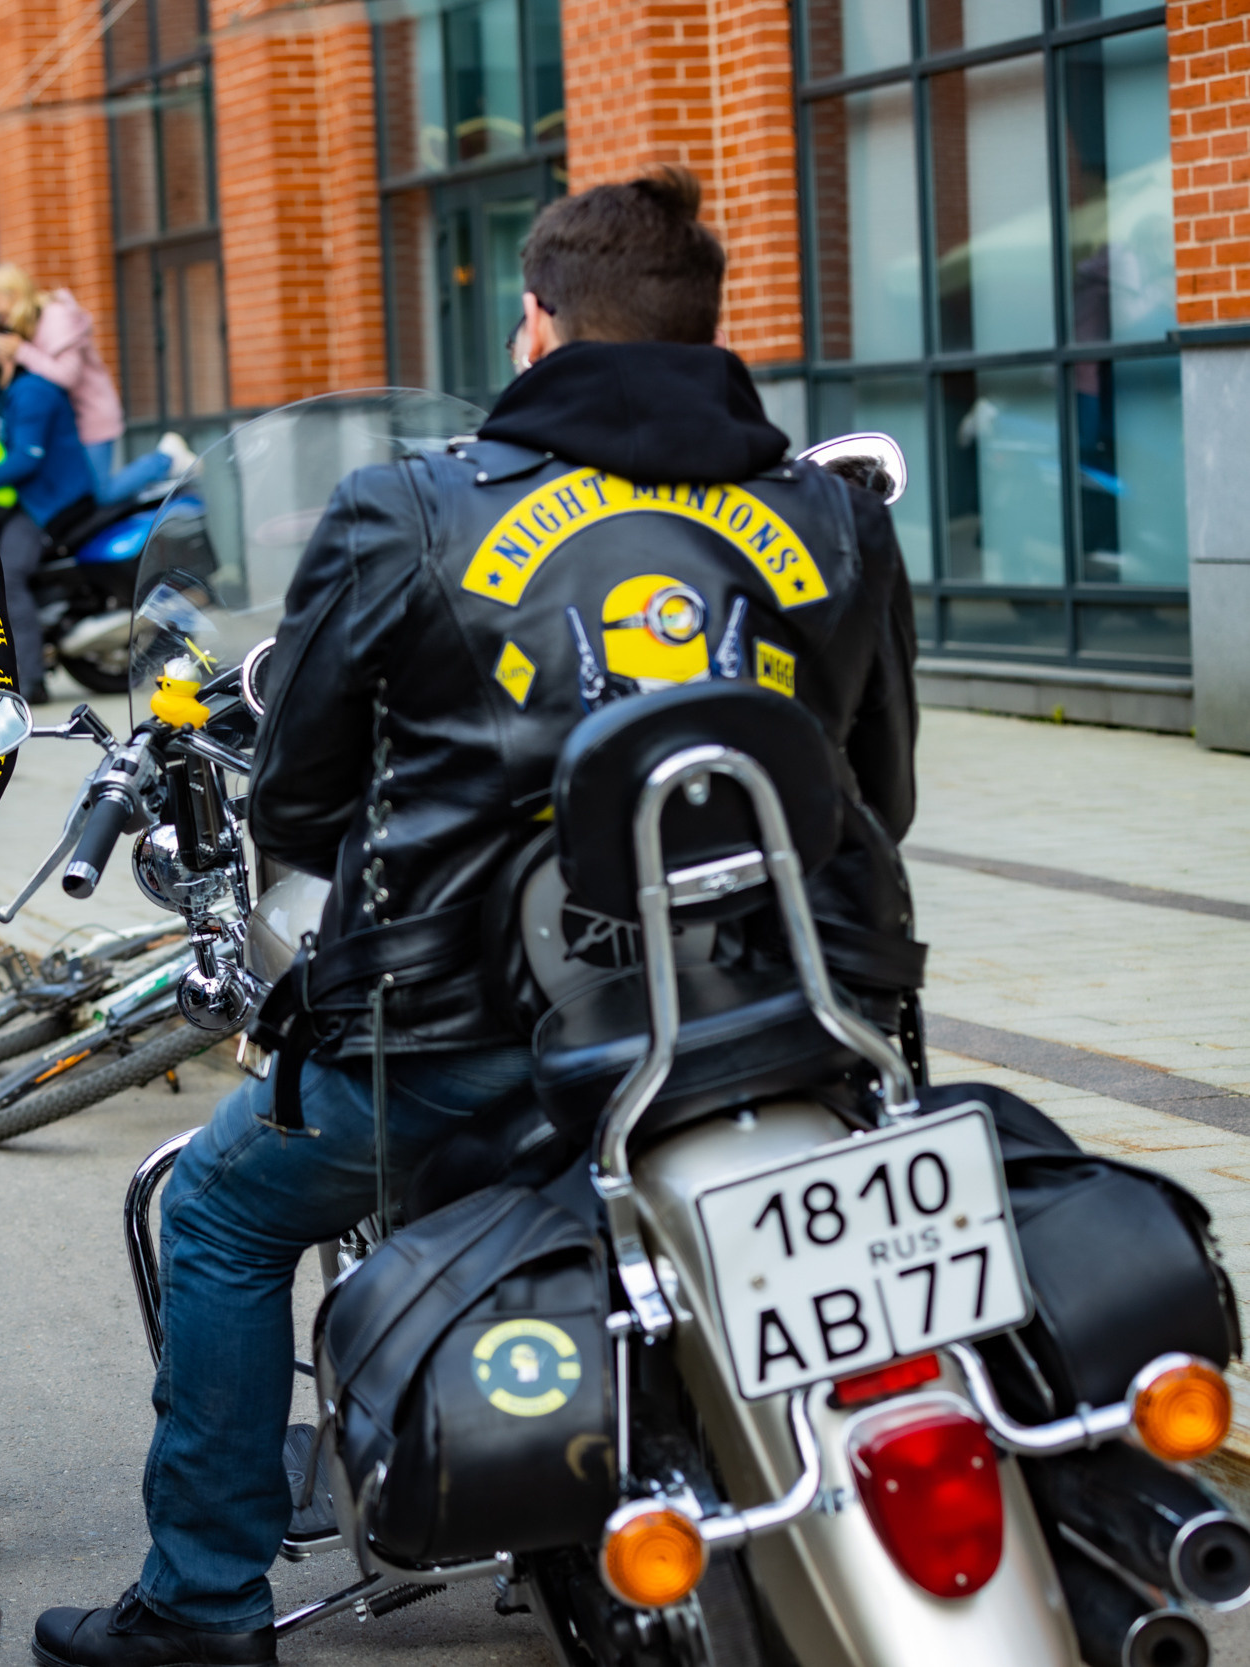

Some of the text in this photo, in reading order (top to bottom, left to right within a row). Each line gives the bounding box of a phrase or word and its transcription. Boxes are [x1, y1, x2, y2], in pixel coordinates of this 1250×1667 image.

[494, 473, 609, 571] NIGHT
[754, 1151, 949, 1257] 1810
[868, 1226, 941, 1266] RUS
[758, 1246, 988, 1383] AB 77
